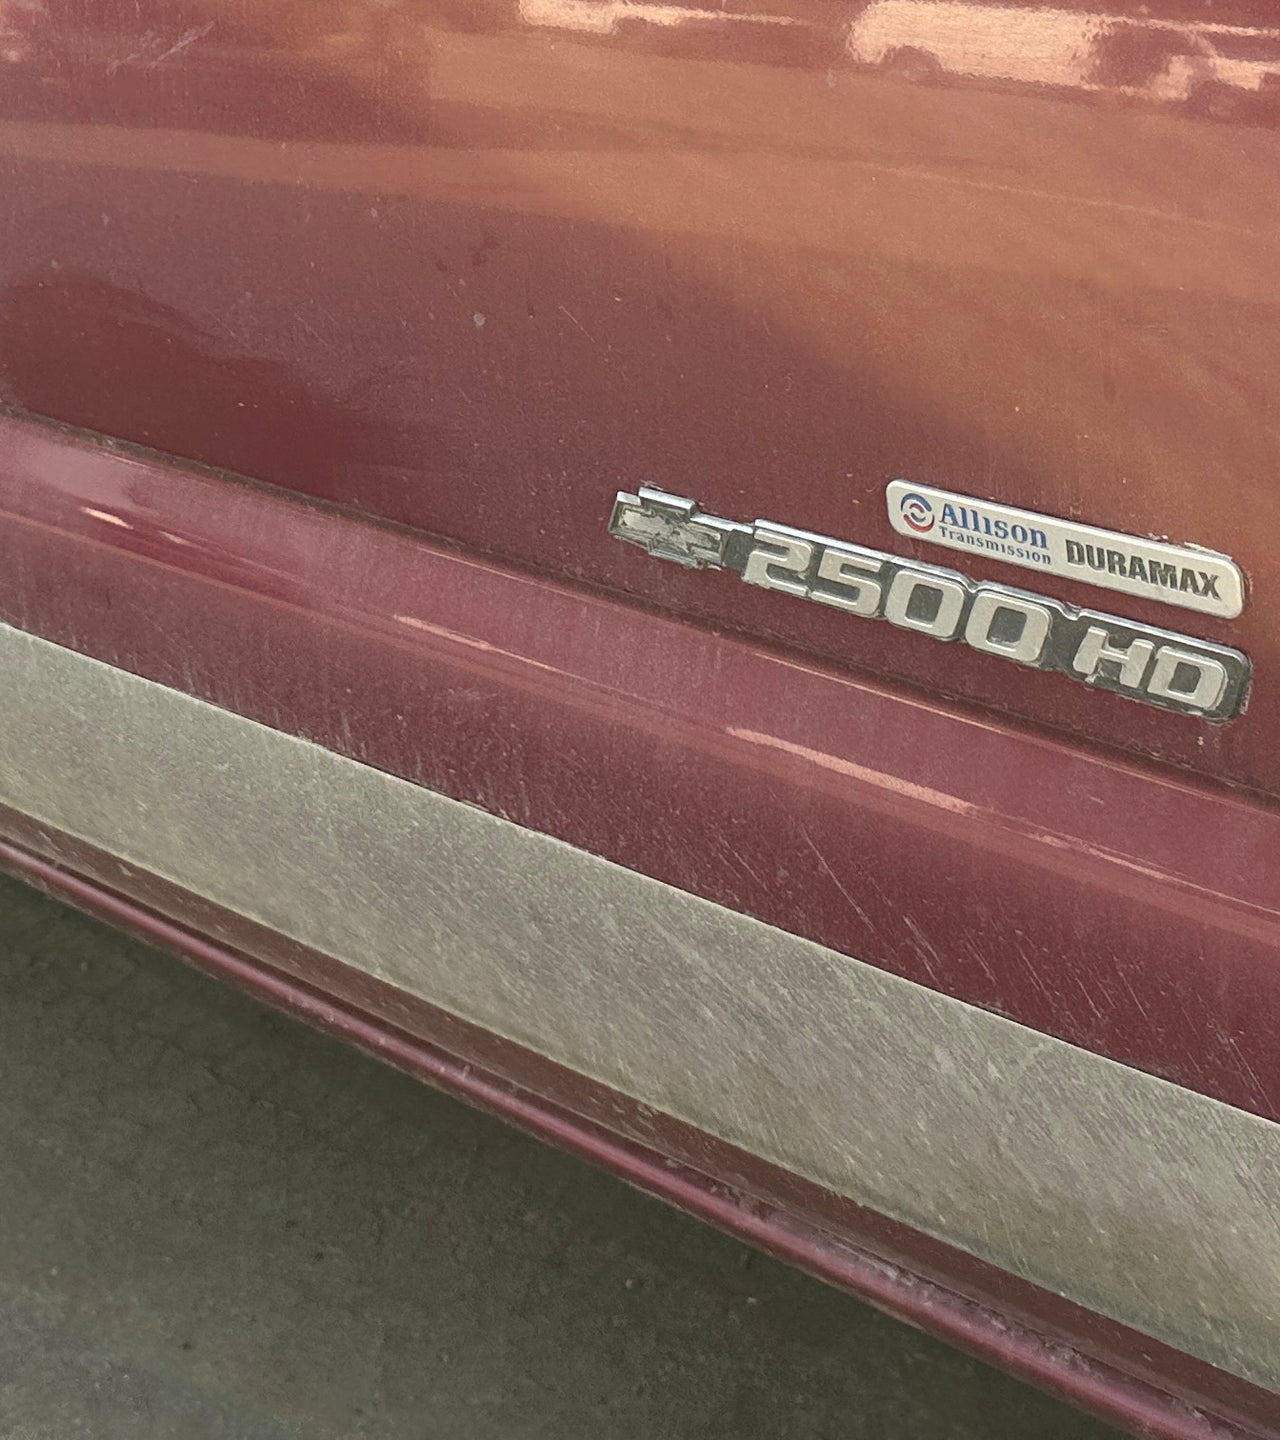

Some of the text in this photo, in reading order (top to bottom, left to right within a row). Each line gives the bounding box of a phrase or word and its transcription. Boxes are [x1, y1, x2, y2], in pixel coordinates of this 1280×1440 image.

[939, 503, 1048, 550] Allison
[939, 525, 1052, 566] Transmission
[1065, 539, 1223, 600] DURAMAX
[740, 528, 1230, 711] 2500 HD
